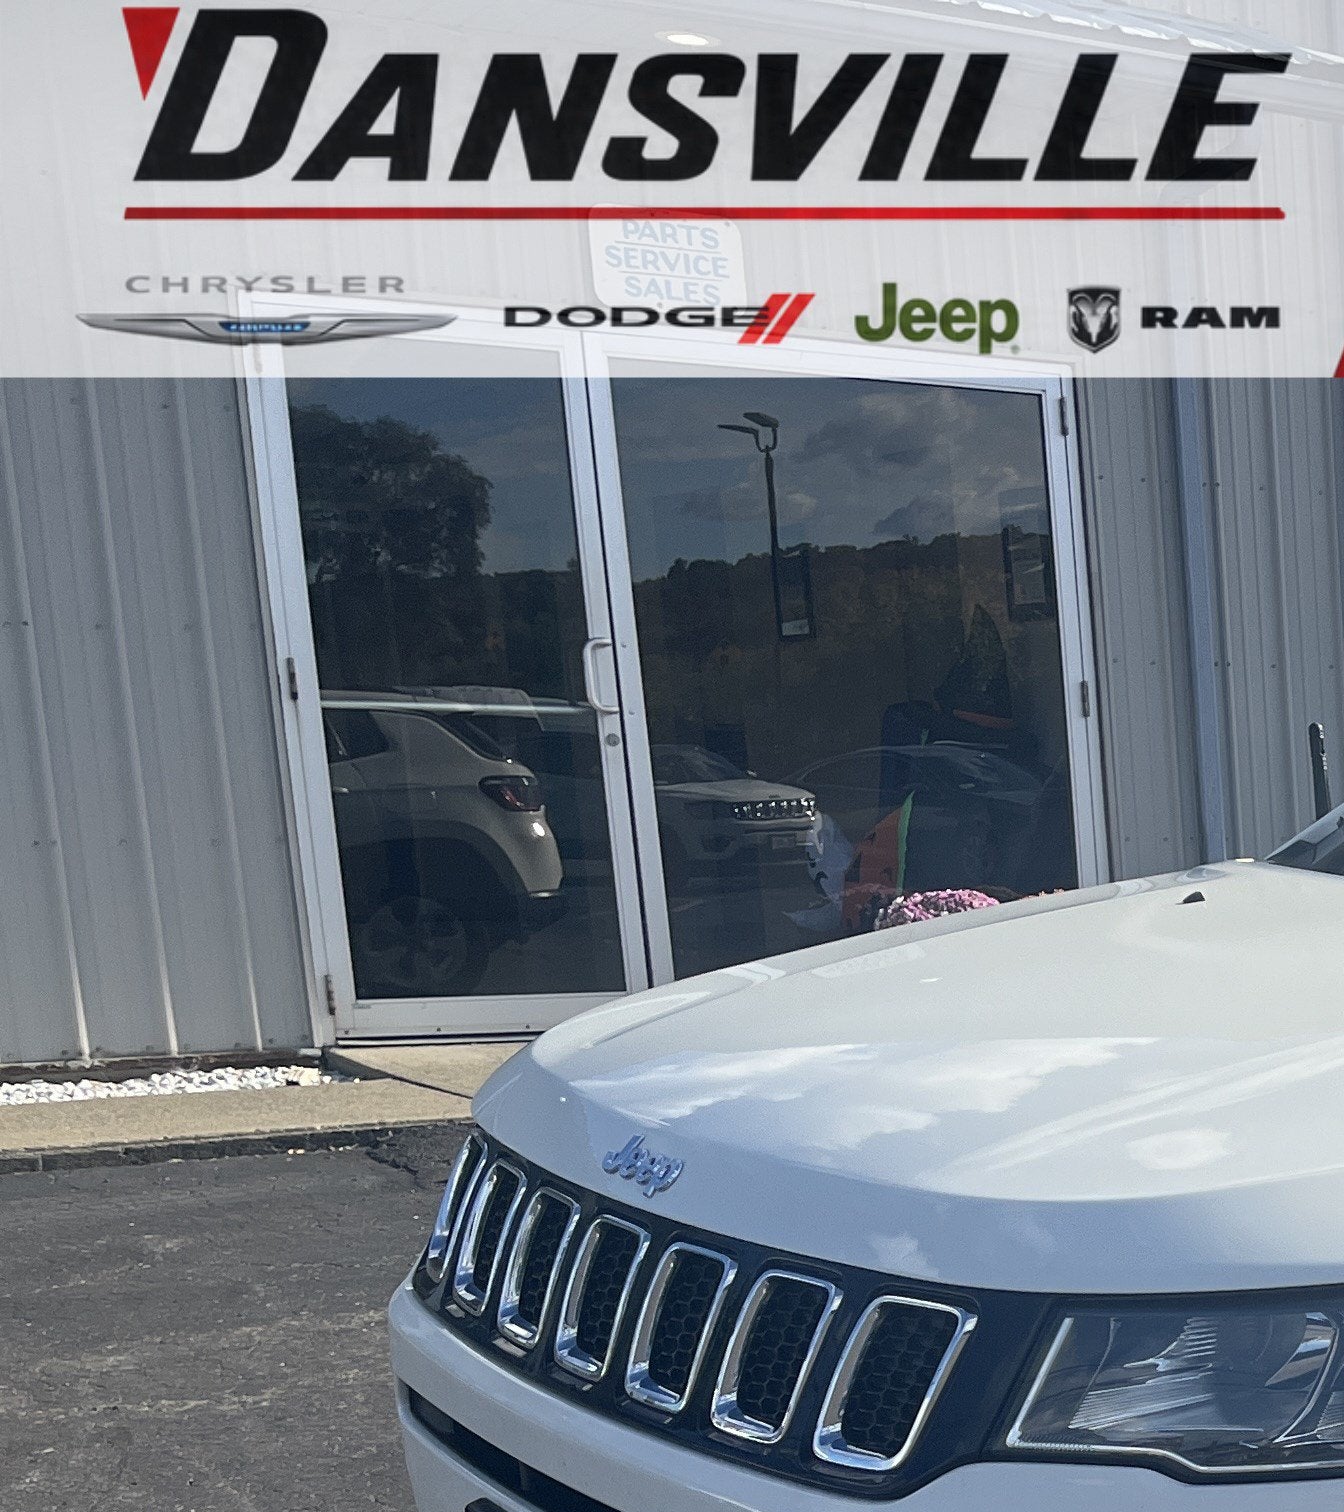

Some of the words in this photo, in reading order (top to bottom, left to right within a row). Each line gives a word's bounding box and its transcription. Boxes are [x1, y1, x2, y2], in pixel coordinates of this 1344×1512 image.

[622, 218, 719, 250] PARTS
[604, 245, 730, 279] SERVICE
[624, 275, 722, 308] SALES
[602, 1134, 684, 1199] Jeep
